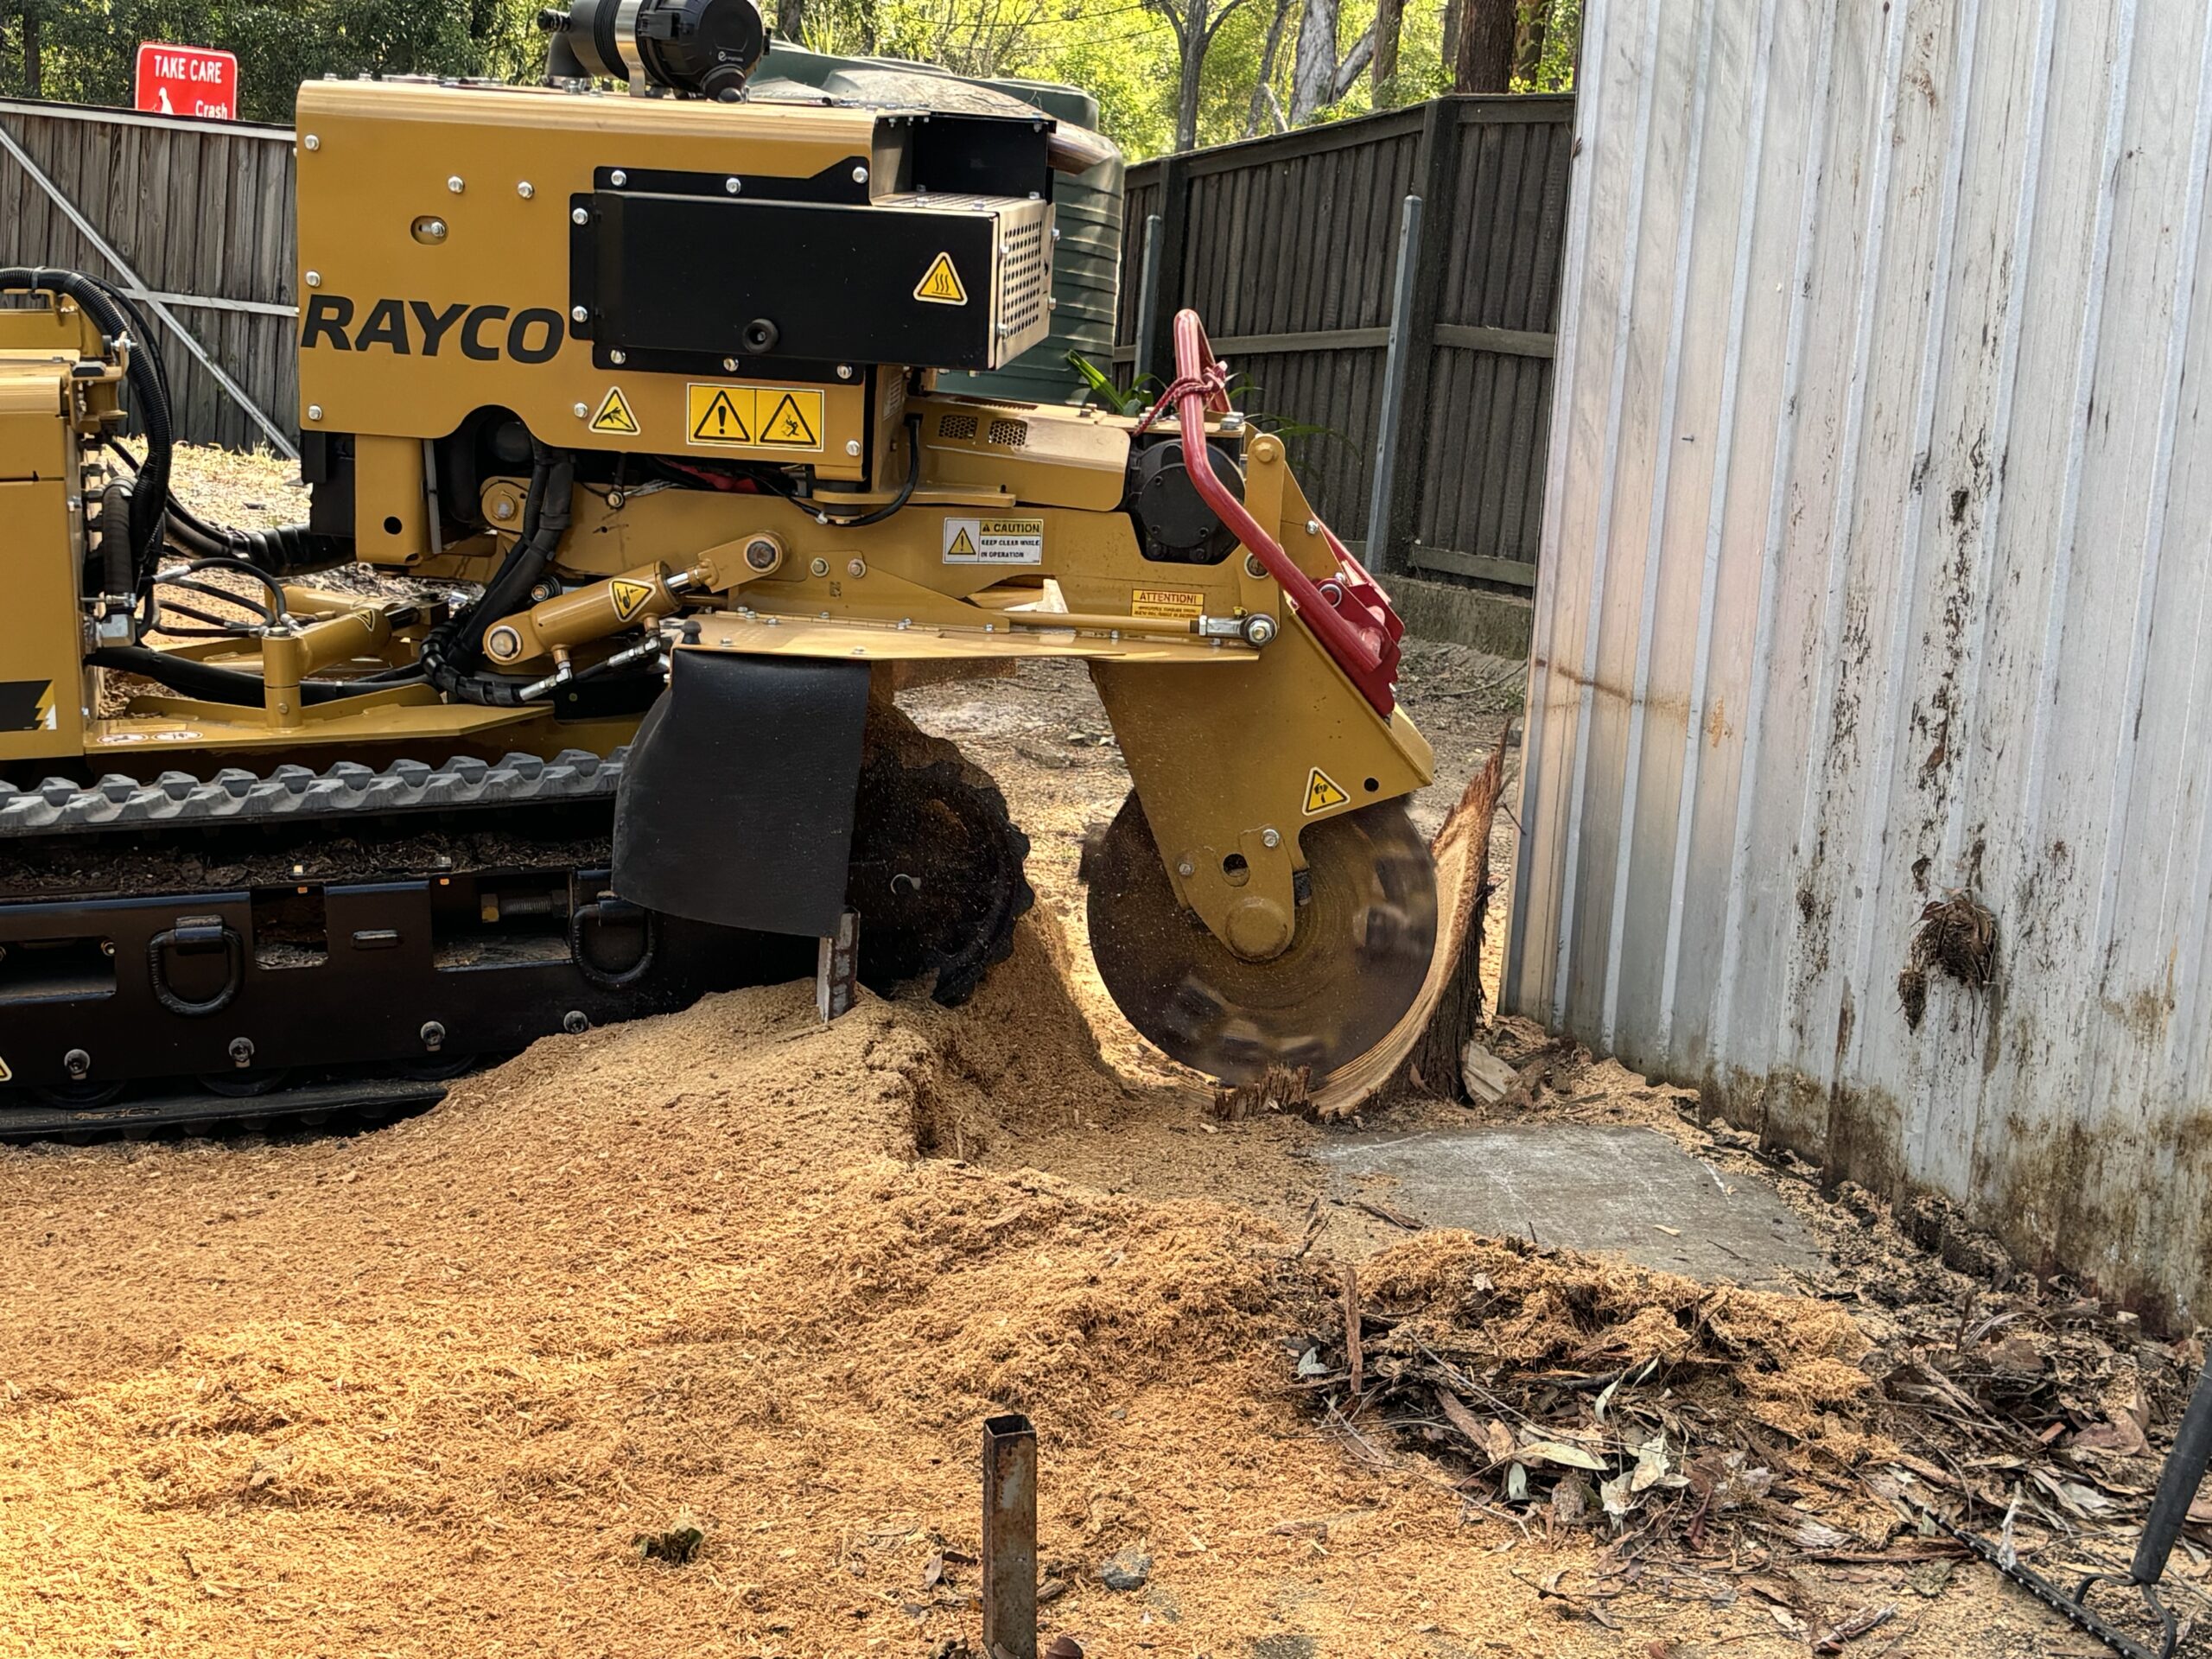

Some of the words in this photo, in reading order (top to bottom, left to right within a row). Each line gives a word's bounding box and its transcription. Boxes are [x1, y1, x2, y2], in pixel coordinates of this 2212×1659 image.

[154, 54, 186, 79] TAKE
[189, 60, 222, 84] CARE
[195, 99, 228, 120] Crash
[301, 294, 564, 364] RAYCO
[994, 524, 1039, 532] CAUTION
